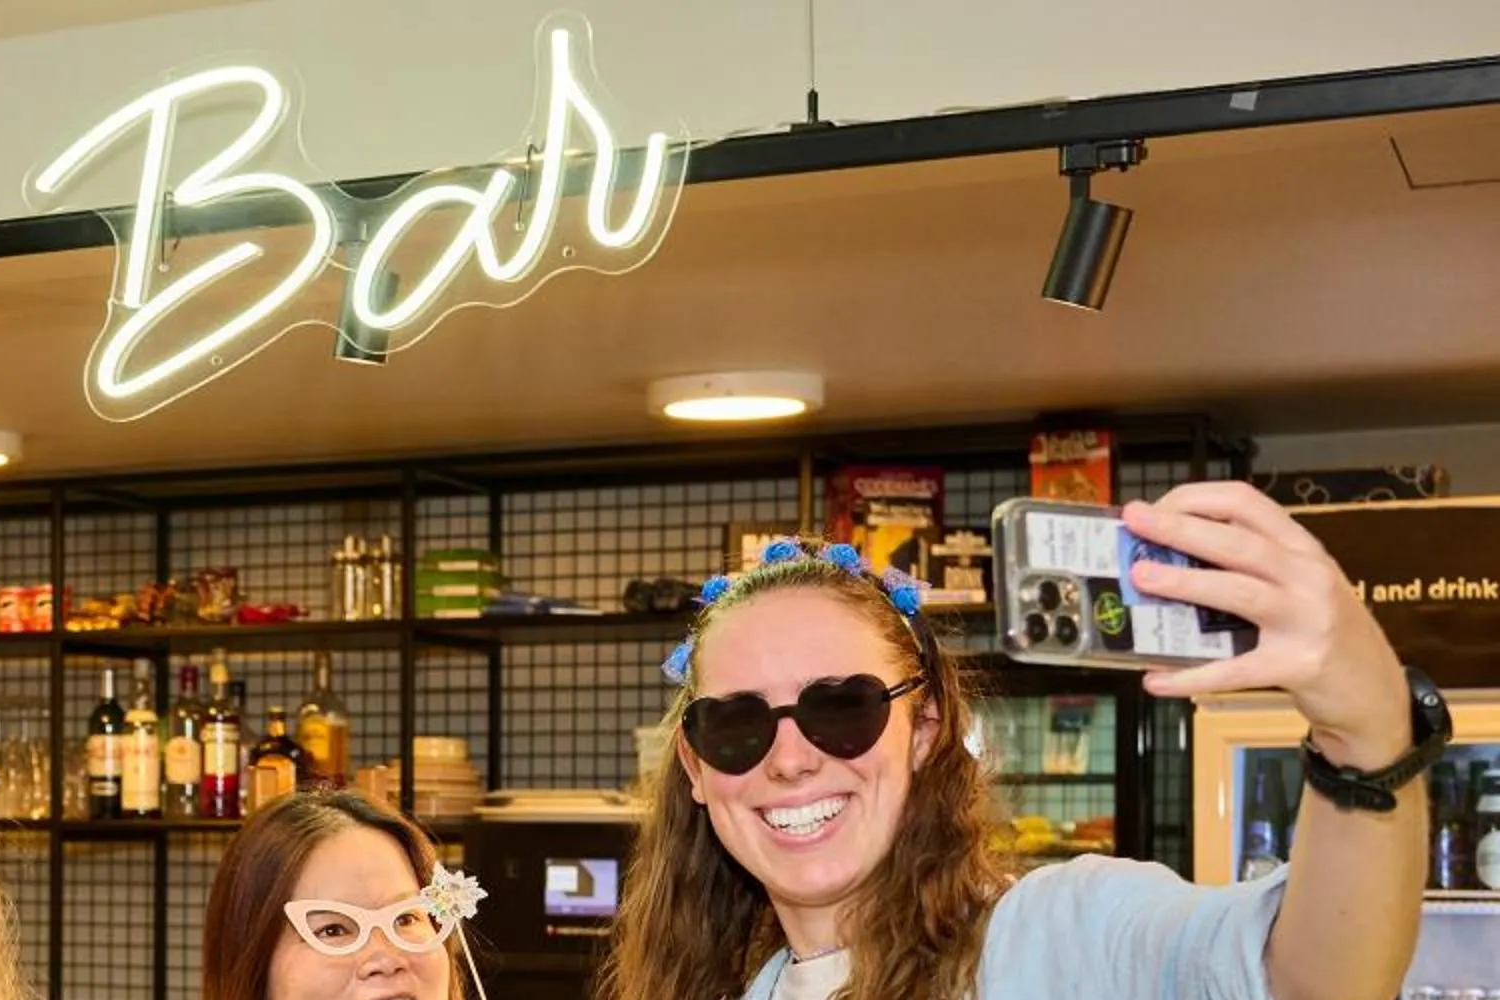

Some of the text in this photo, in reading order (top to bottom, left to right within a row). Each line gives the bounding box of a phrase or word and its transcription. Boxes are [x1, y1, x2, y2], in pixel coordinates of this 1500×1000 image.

[35, 26, 670, 398] Bar
[1372, 577, 1422, 602] and
[1427, 576, 1499, 601] drink
